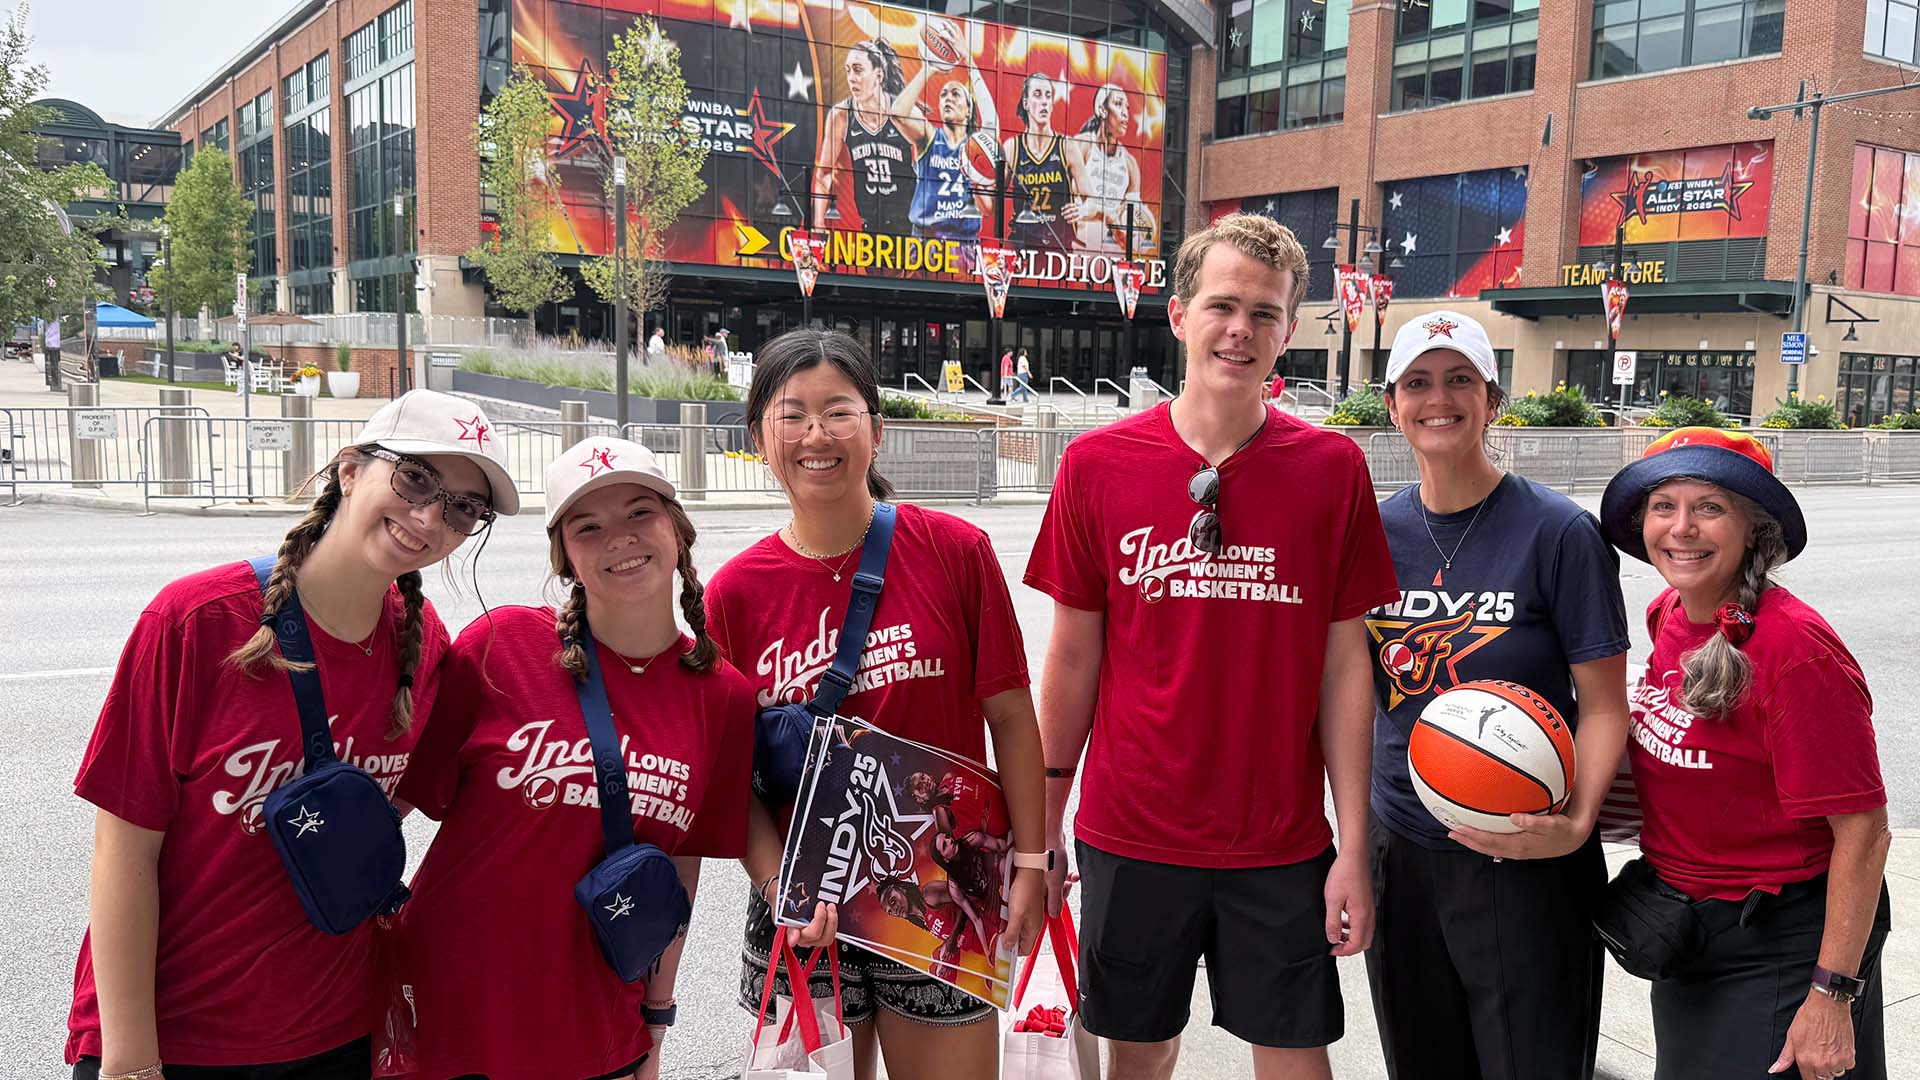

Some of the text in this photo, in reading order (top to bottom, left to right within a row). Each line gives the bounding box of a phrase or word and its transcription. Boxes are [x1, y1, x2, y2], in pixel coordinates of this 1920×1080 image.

[687, 100, 734, 117] WNBA
[682, 115, 753, 140] STAR
[690, 138, 734, 152] 2025
[864, 159, 892, 183] 30
[930, 155, 960, 170] MINNES
[938, 172, 965, 197] 24
[1019, 171, 1063, 186] INDIANA
[1687, 180, 1714, 189] WNBA
[937, 200, 963, 211] MAYO
[1030, 187, 1052, 211] 22
[1646, 188, 1725, 205] ALL STAR
[1656, 202, 1712, 212] INDY 2025
[1562, 263, 1607, 287] TEAM
[1118, 509, 1276, 586] Ind LOVES
[1189, 562, 1276, 581] WOMEN'S
[1170, 579, 1303, 604] BASKETBALL
[1368, 590, 1515, 622] NDY 25
[863, 623, 913, 649] OVES
[857, 641, 917, 672] MEN'S
[812, 658, 945, 697] SKETBALL
[497, 720, 690, 790] Ind LOVES
[1630, 716, 1713, 769] BASKETBALL
[593, 768, 688, 802] MEN'S
[562, 783, 695, 833] BAETBALL
[817, 751, 878, 904] INDY 25
